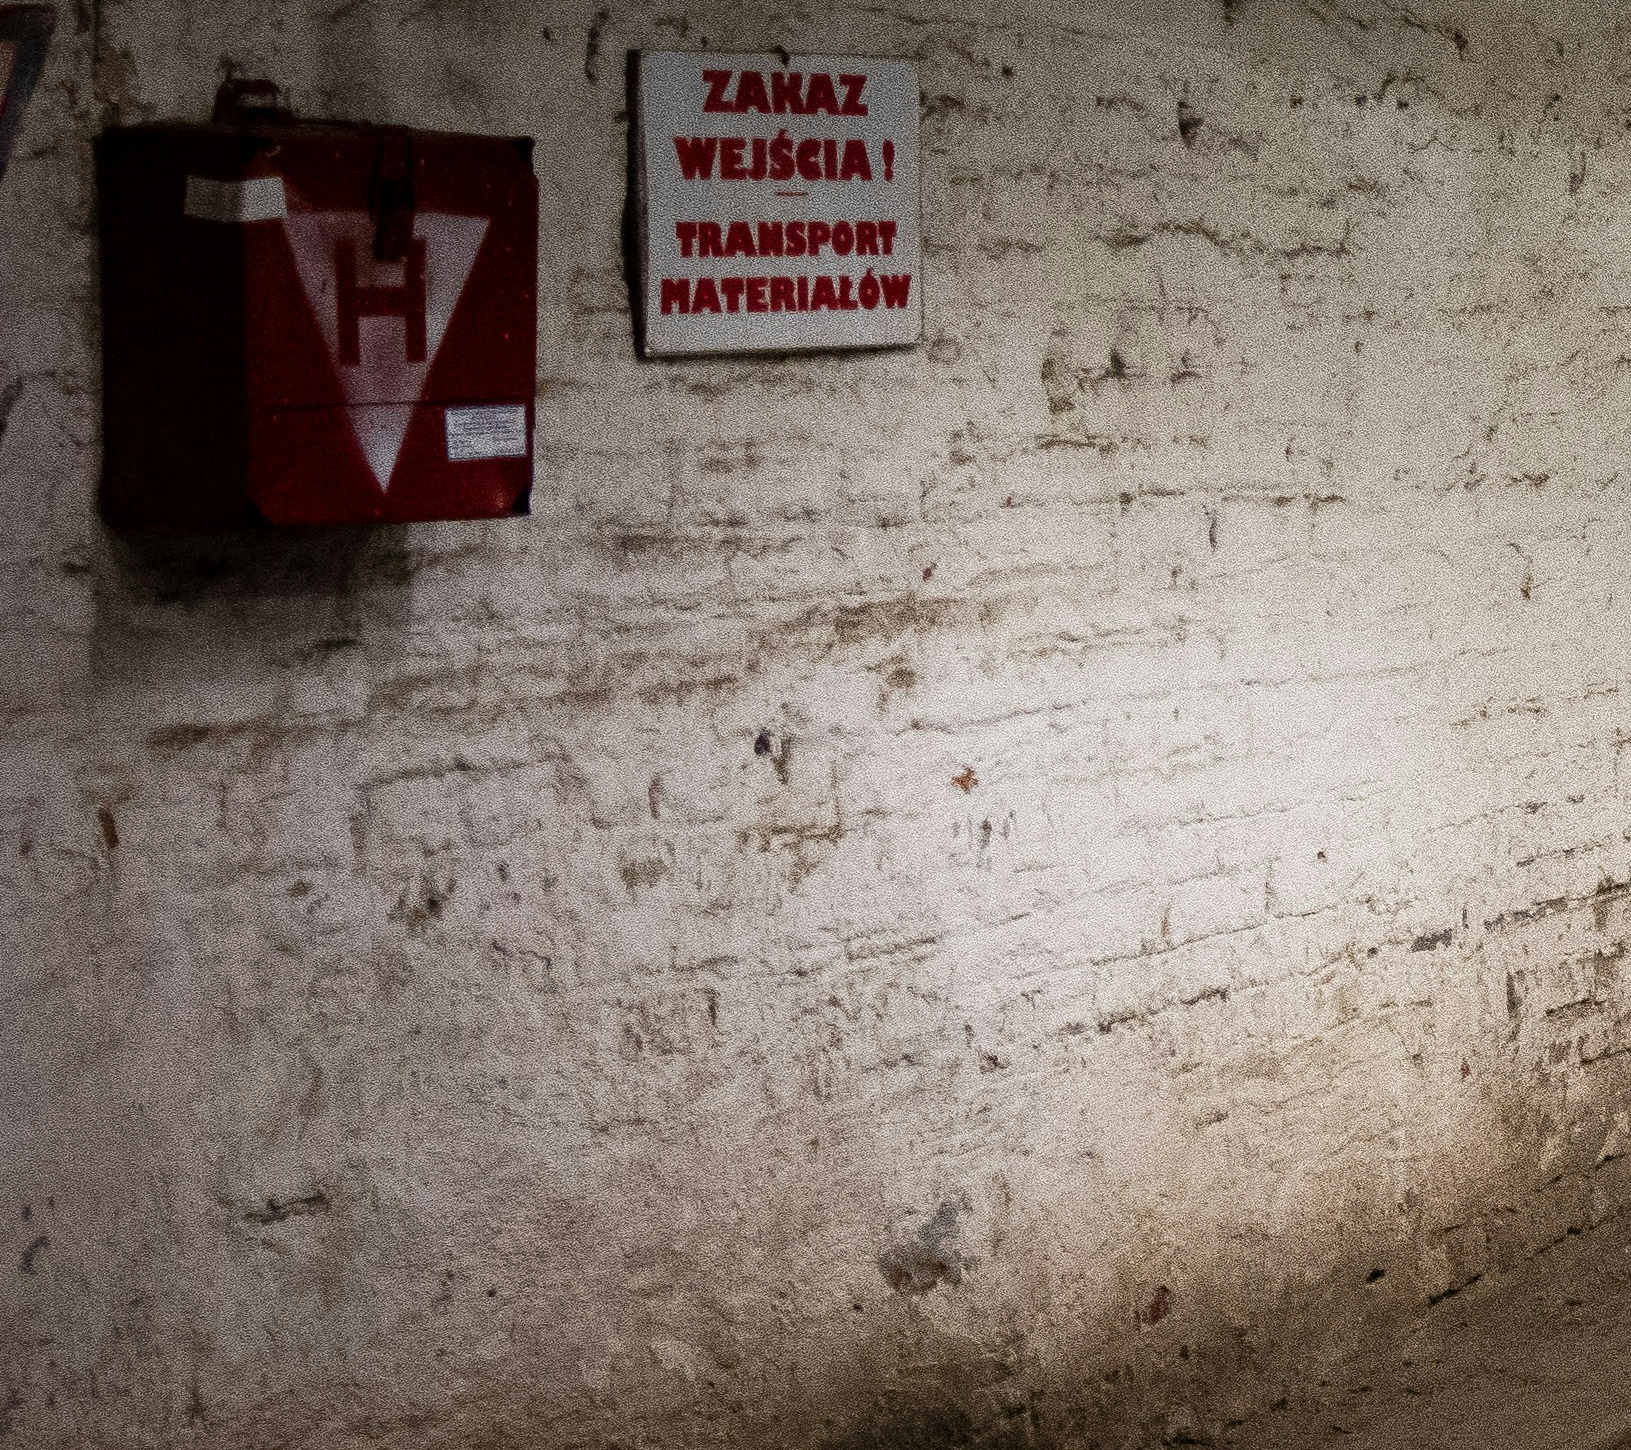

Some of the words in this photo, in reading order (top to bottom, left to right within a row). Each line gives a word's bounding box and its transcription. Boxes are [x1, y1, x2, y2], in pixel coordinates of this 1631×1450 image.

[702, 69, 869, 117] ZAKAZ
[674, 219, 898, 258] TRANSPORT
[334, 238, 427, 368] H
[659, 266, 912, 316] MATERIAŁÓW
